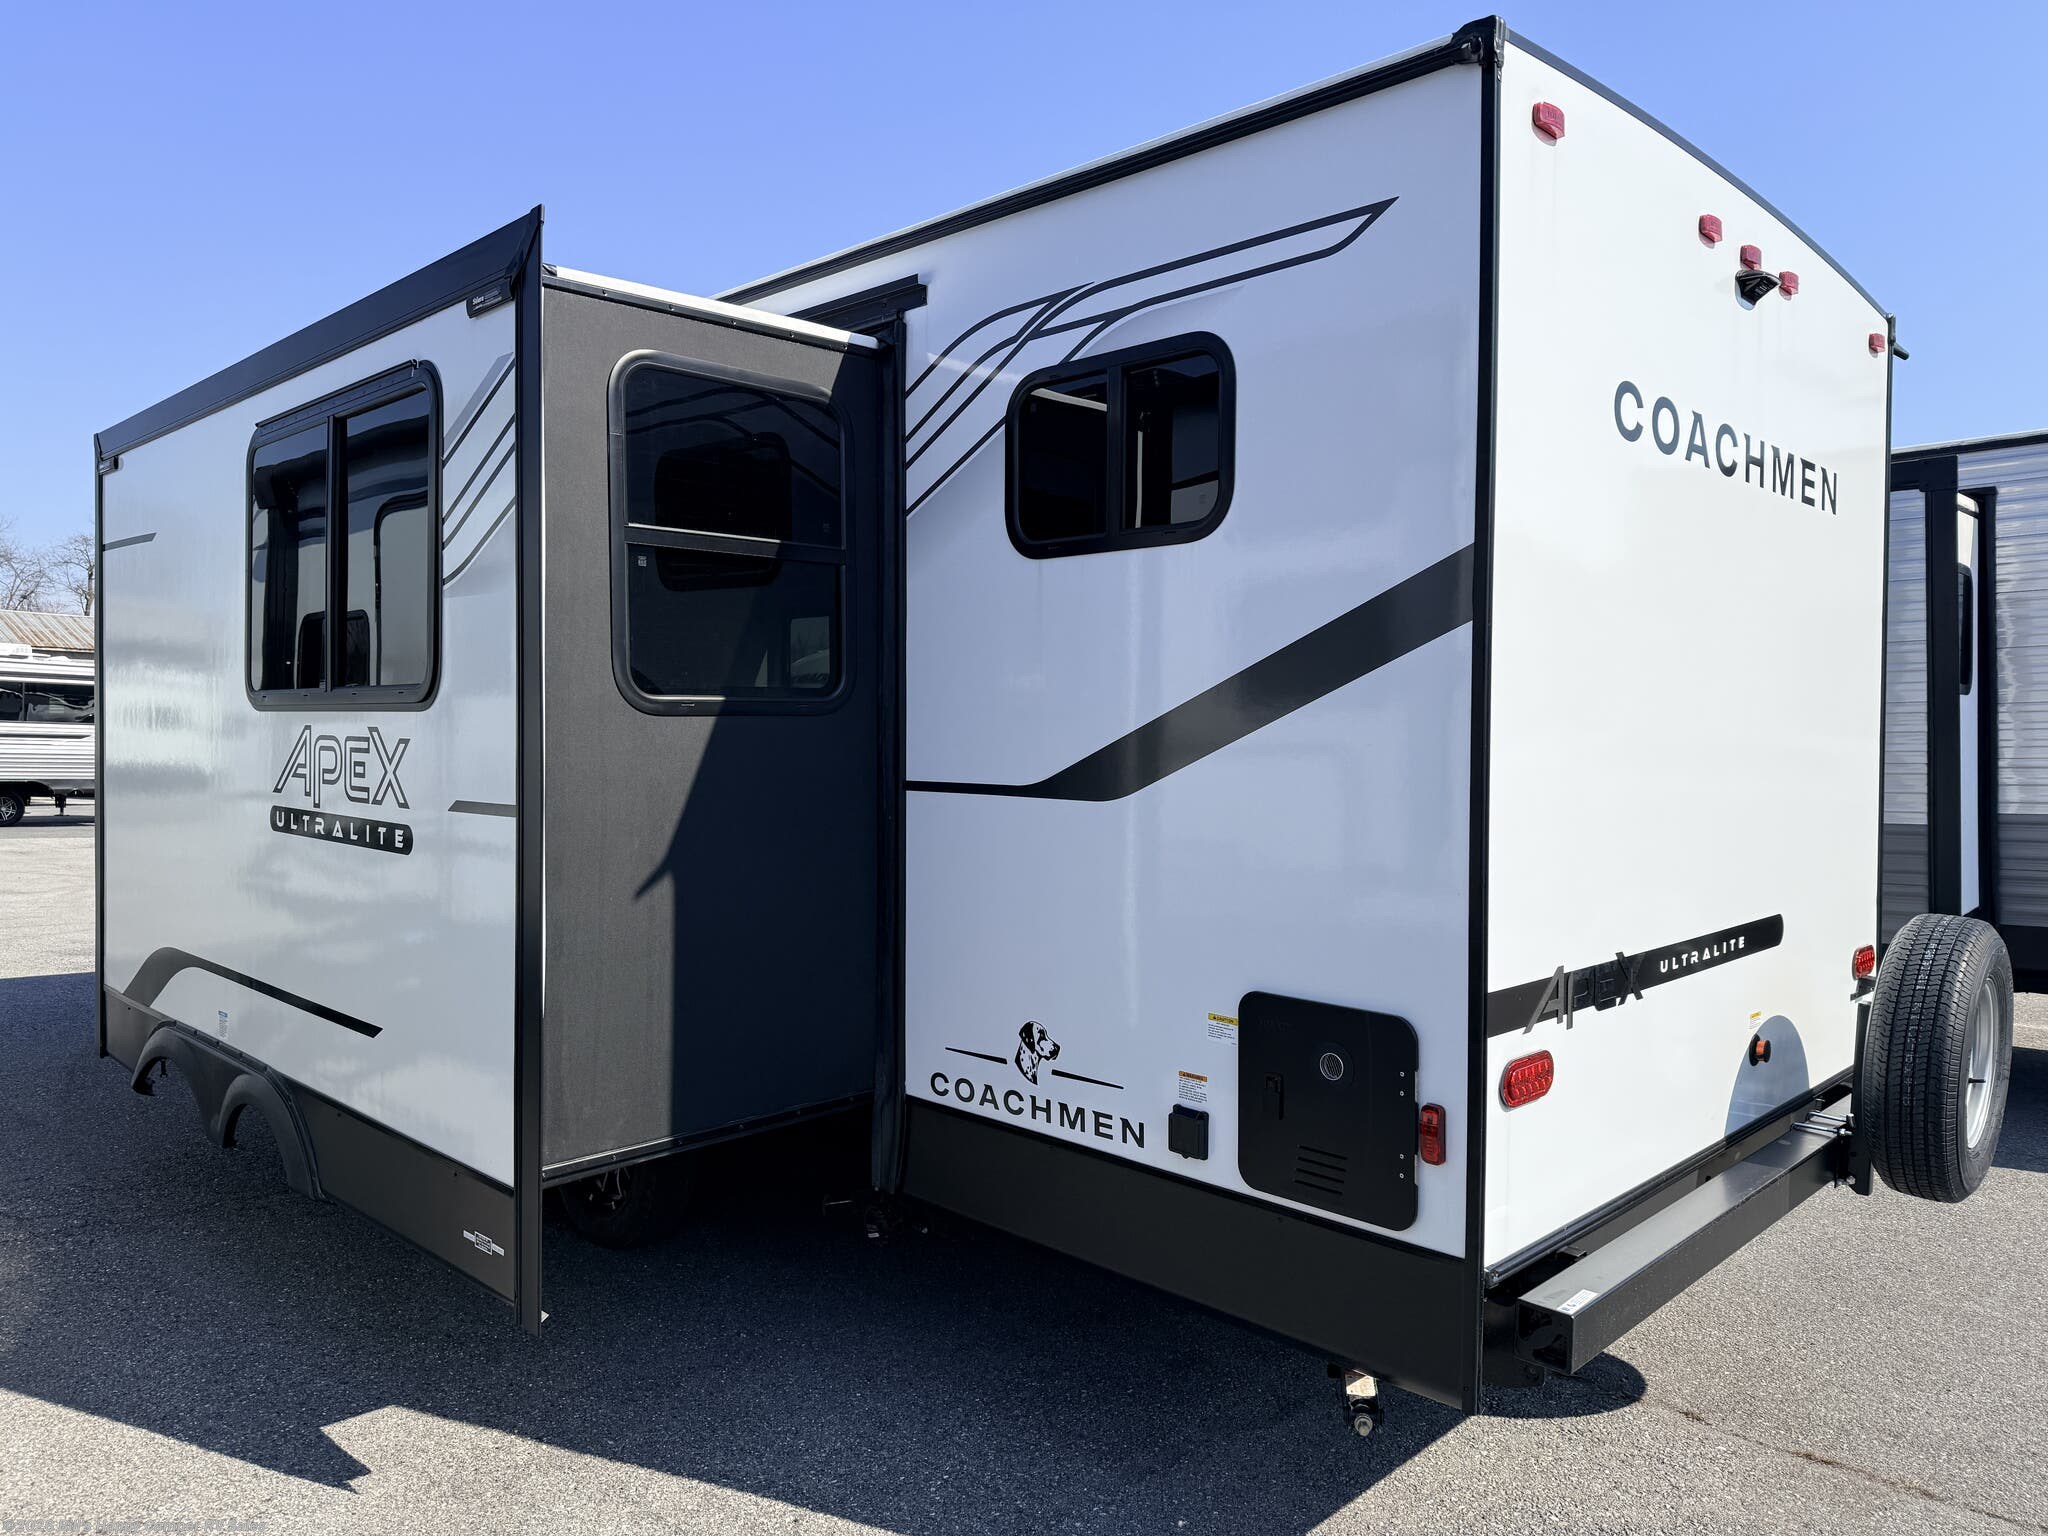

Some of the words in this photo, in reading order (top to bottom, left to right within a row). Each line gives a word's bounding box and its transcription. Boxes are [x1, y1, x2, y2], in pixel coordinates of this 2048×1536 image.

[1614, 380, 1837, 515] COACHMEN
[272, 725, 411, 809] APEX
[276, 810, 404, 848] ULTRALITE
[1522, 951, 1646, 1035] APEX
[1660, 936, 1745, 973] ULTRALITE
[930, 1072, 1145, 1148] COACHMEN
